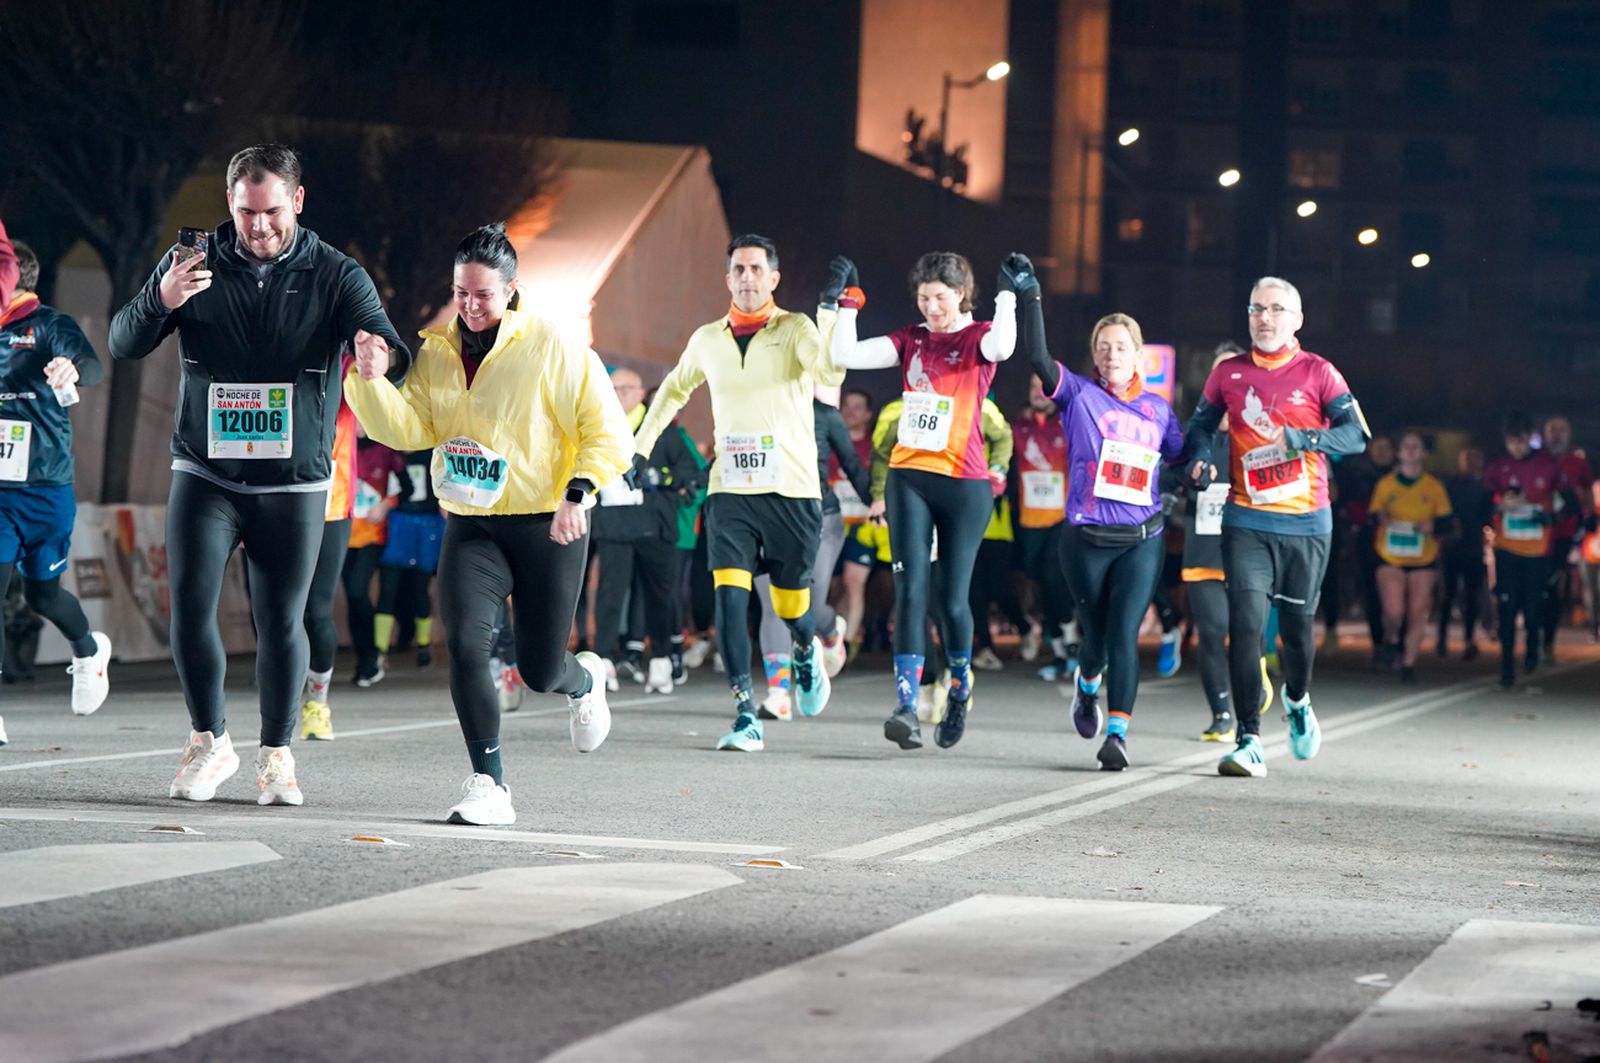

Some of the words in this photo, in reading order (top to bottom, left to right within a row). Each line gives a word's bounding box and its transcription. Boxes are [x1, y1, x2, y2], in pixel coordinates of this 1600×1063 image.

[217, 400, 233, 409] SAN
[234, 398, 262, 409] ANTÓN
[226, 391, 250, 400] NOCHE
[251, 391, 262, 400] DE
[218, 410, 283, 433] 12006
[447, 455, 500, 482] 14034
[732, 452, 766, 469] 1867
[1256, 461, 1293, 485] 9787
